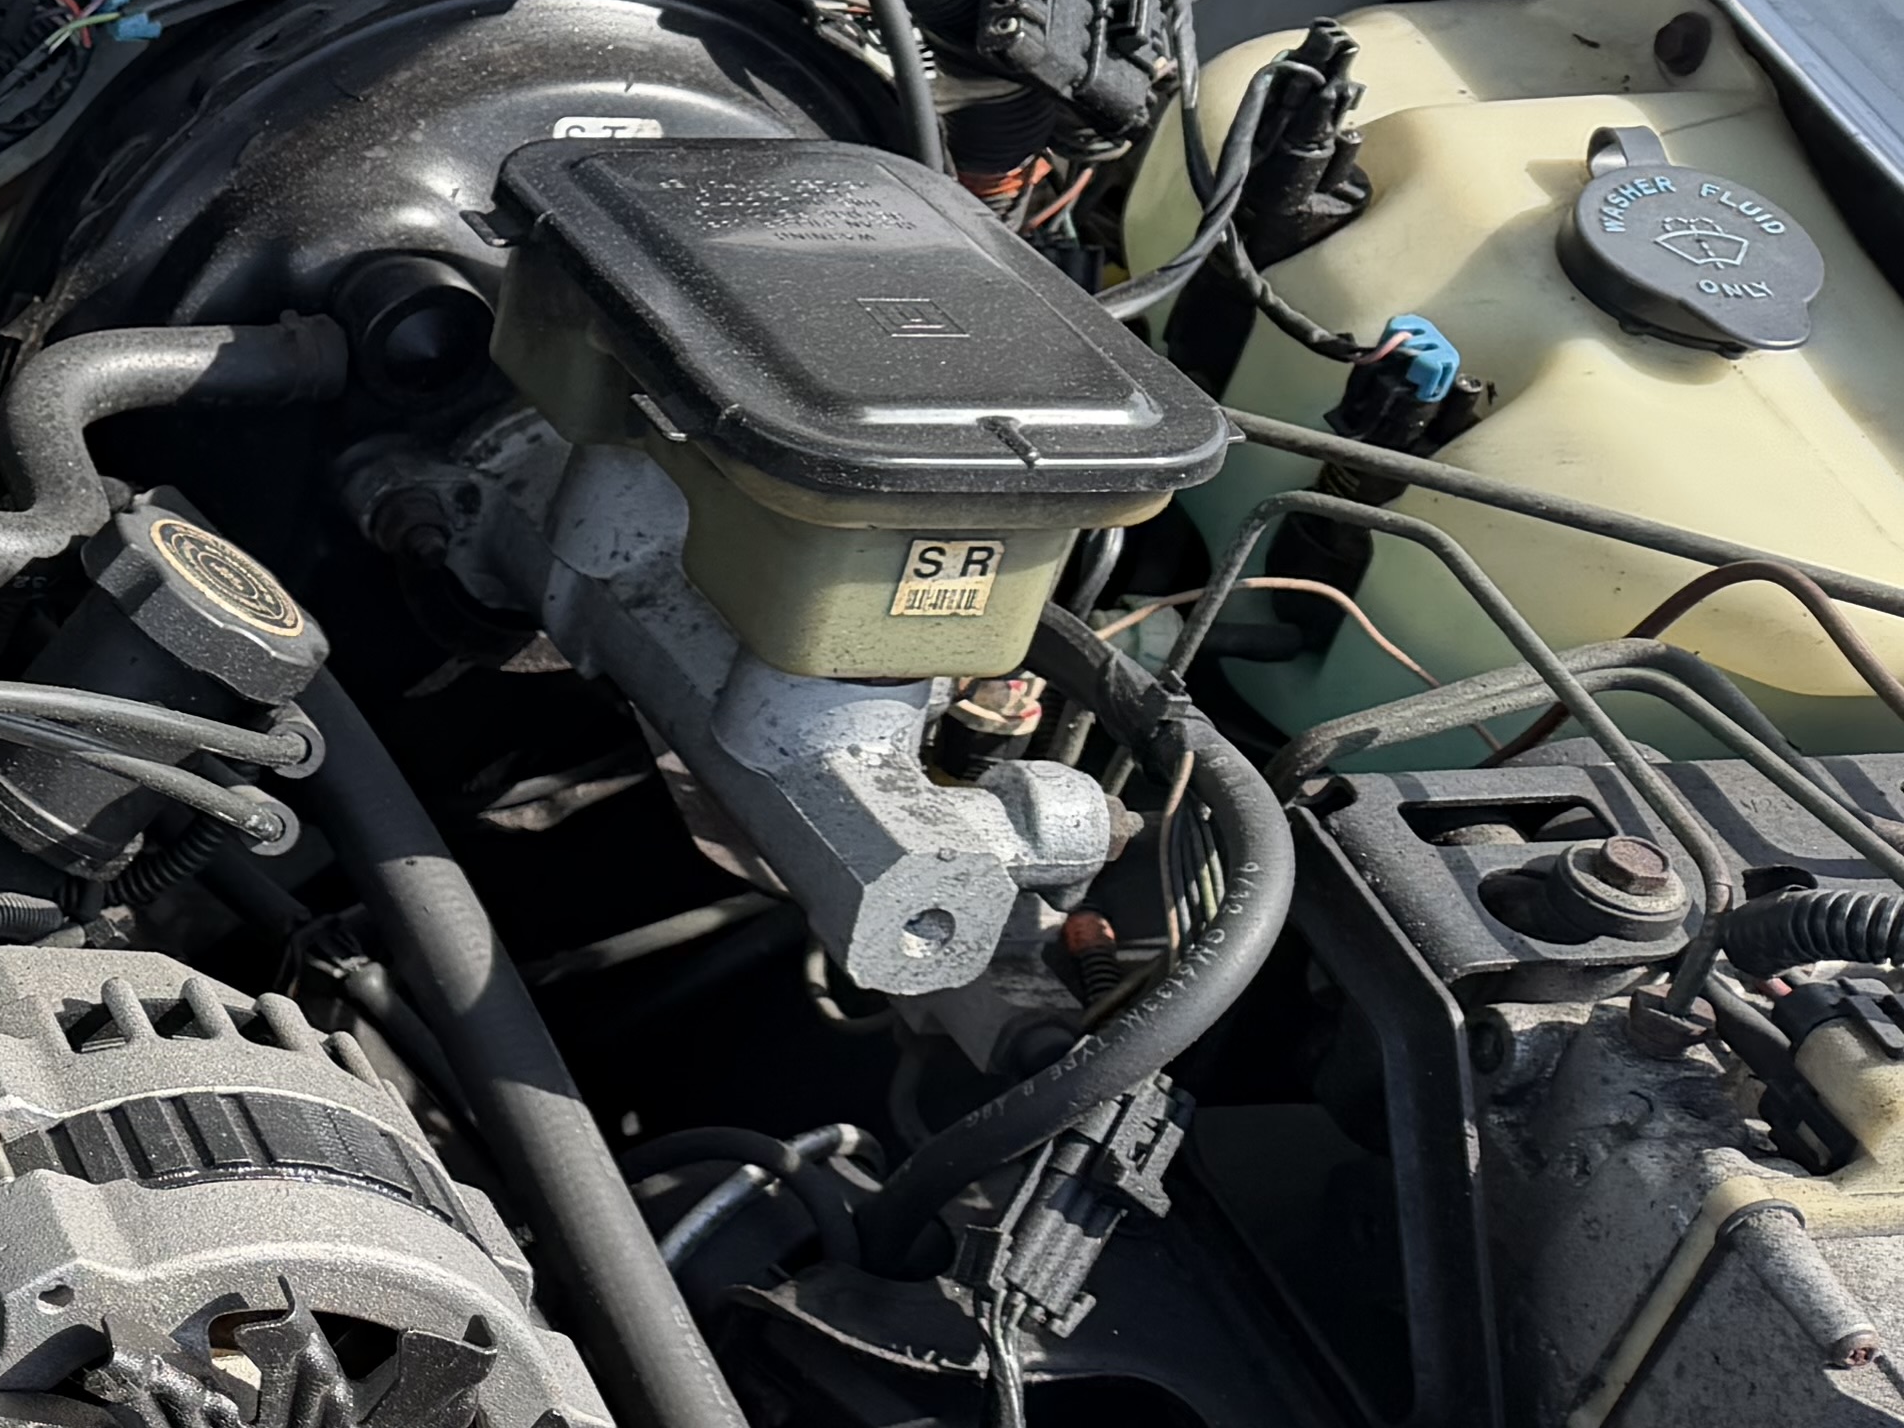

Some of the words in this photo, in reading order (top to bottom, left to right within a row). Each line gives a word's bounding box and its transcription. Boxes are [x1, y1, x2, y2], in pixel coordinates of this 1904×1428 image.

[1600, 175, 1678, 235] WASHER
[1698, 183, 1787, 236] FLUID
[1694, 278, 1775, 300] ONLY
